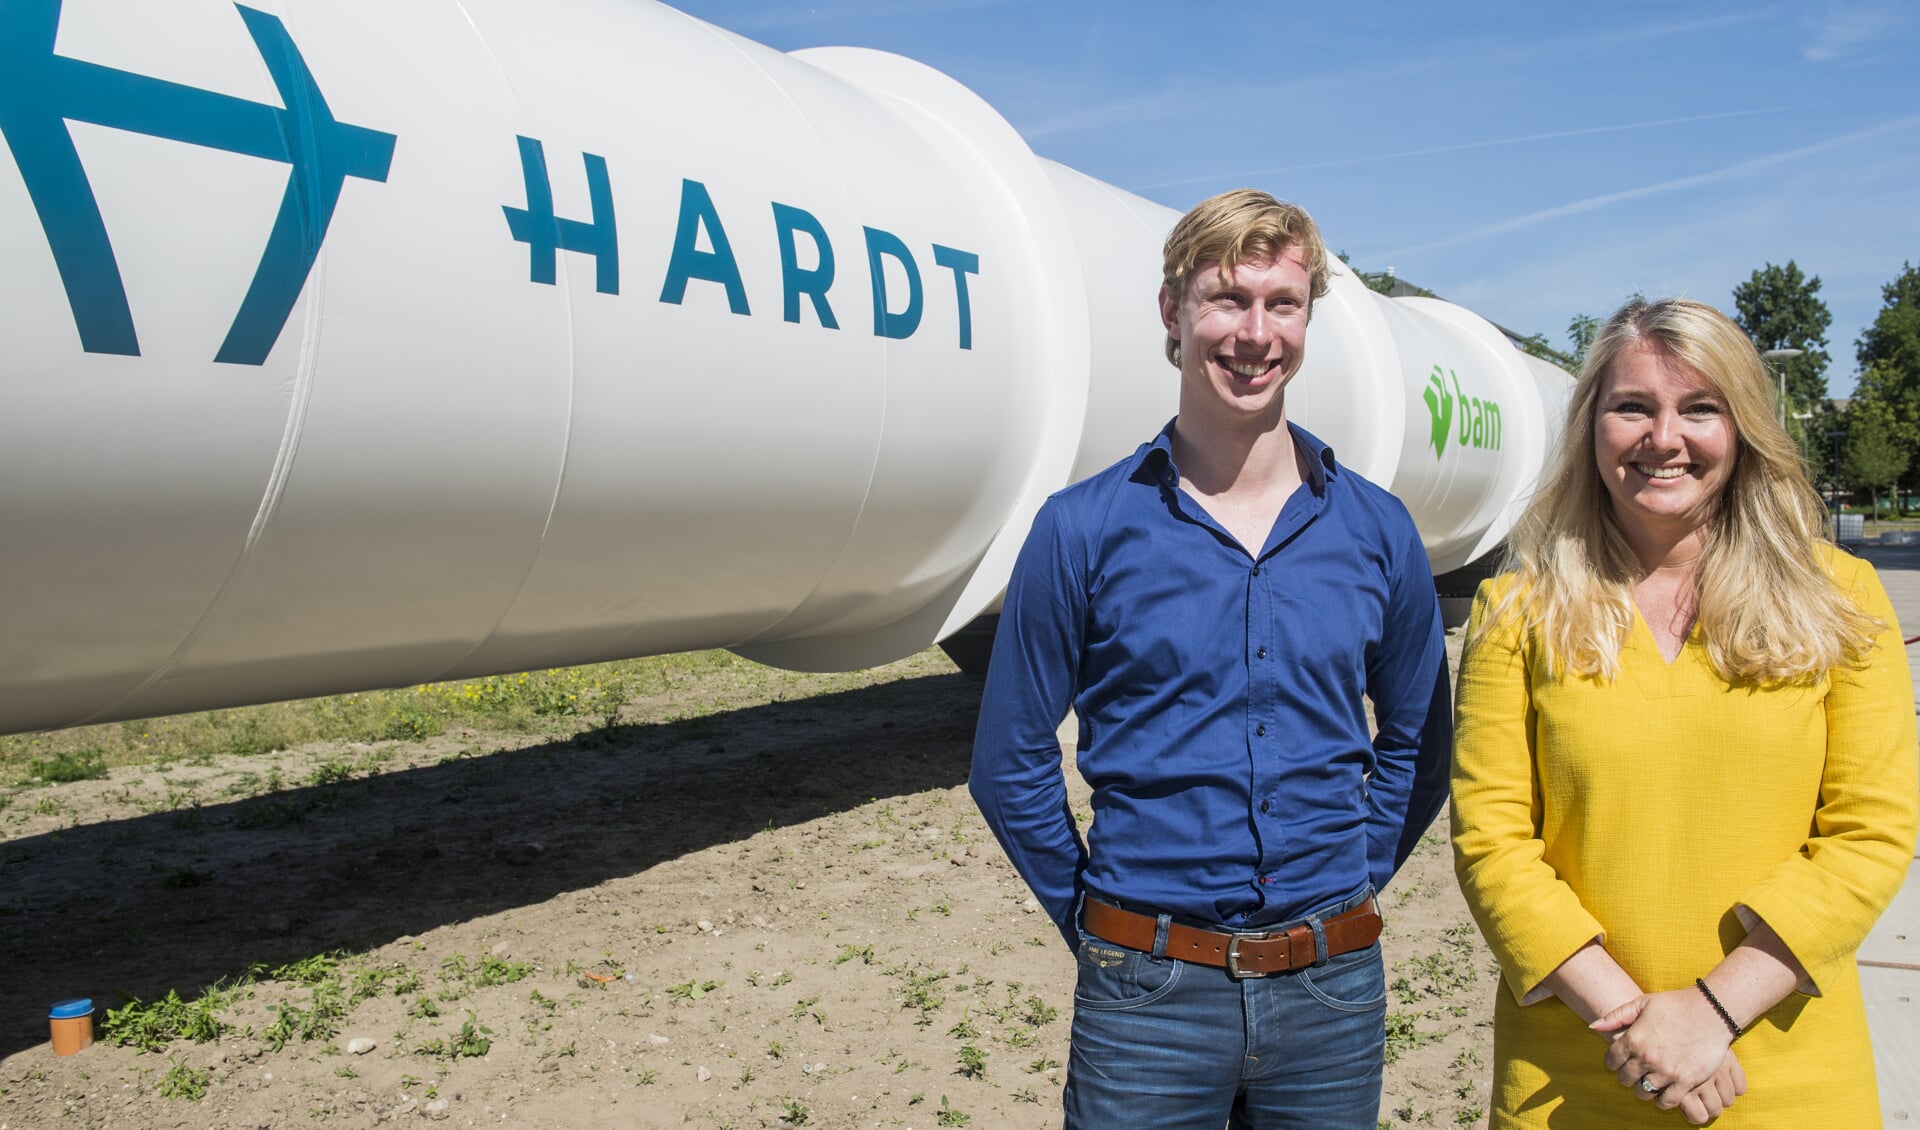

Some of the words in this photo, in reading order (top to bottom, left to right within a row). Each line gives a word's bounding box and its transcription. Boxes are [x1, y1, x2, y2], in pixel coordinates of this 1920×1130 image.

[501, 134, 979, 350] HARDT
[1450, 368, 1502, 451] bam
[1101, 949, 1125, 958] LEGEND
